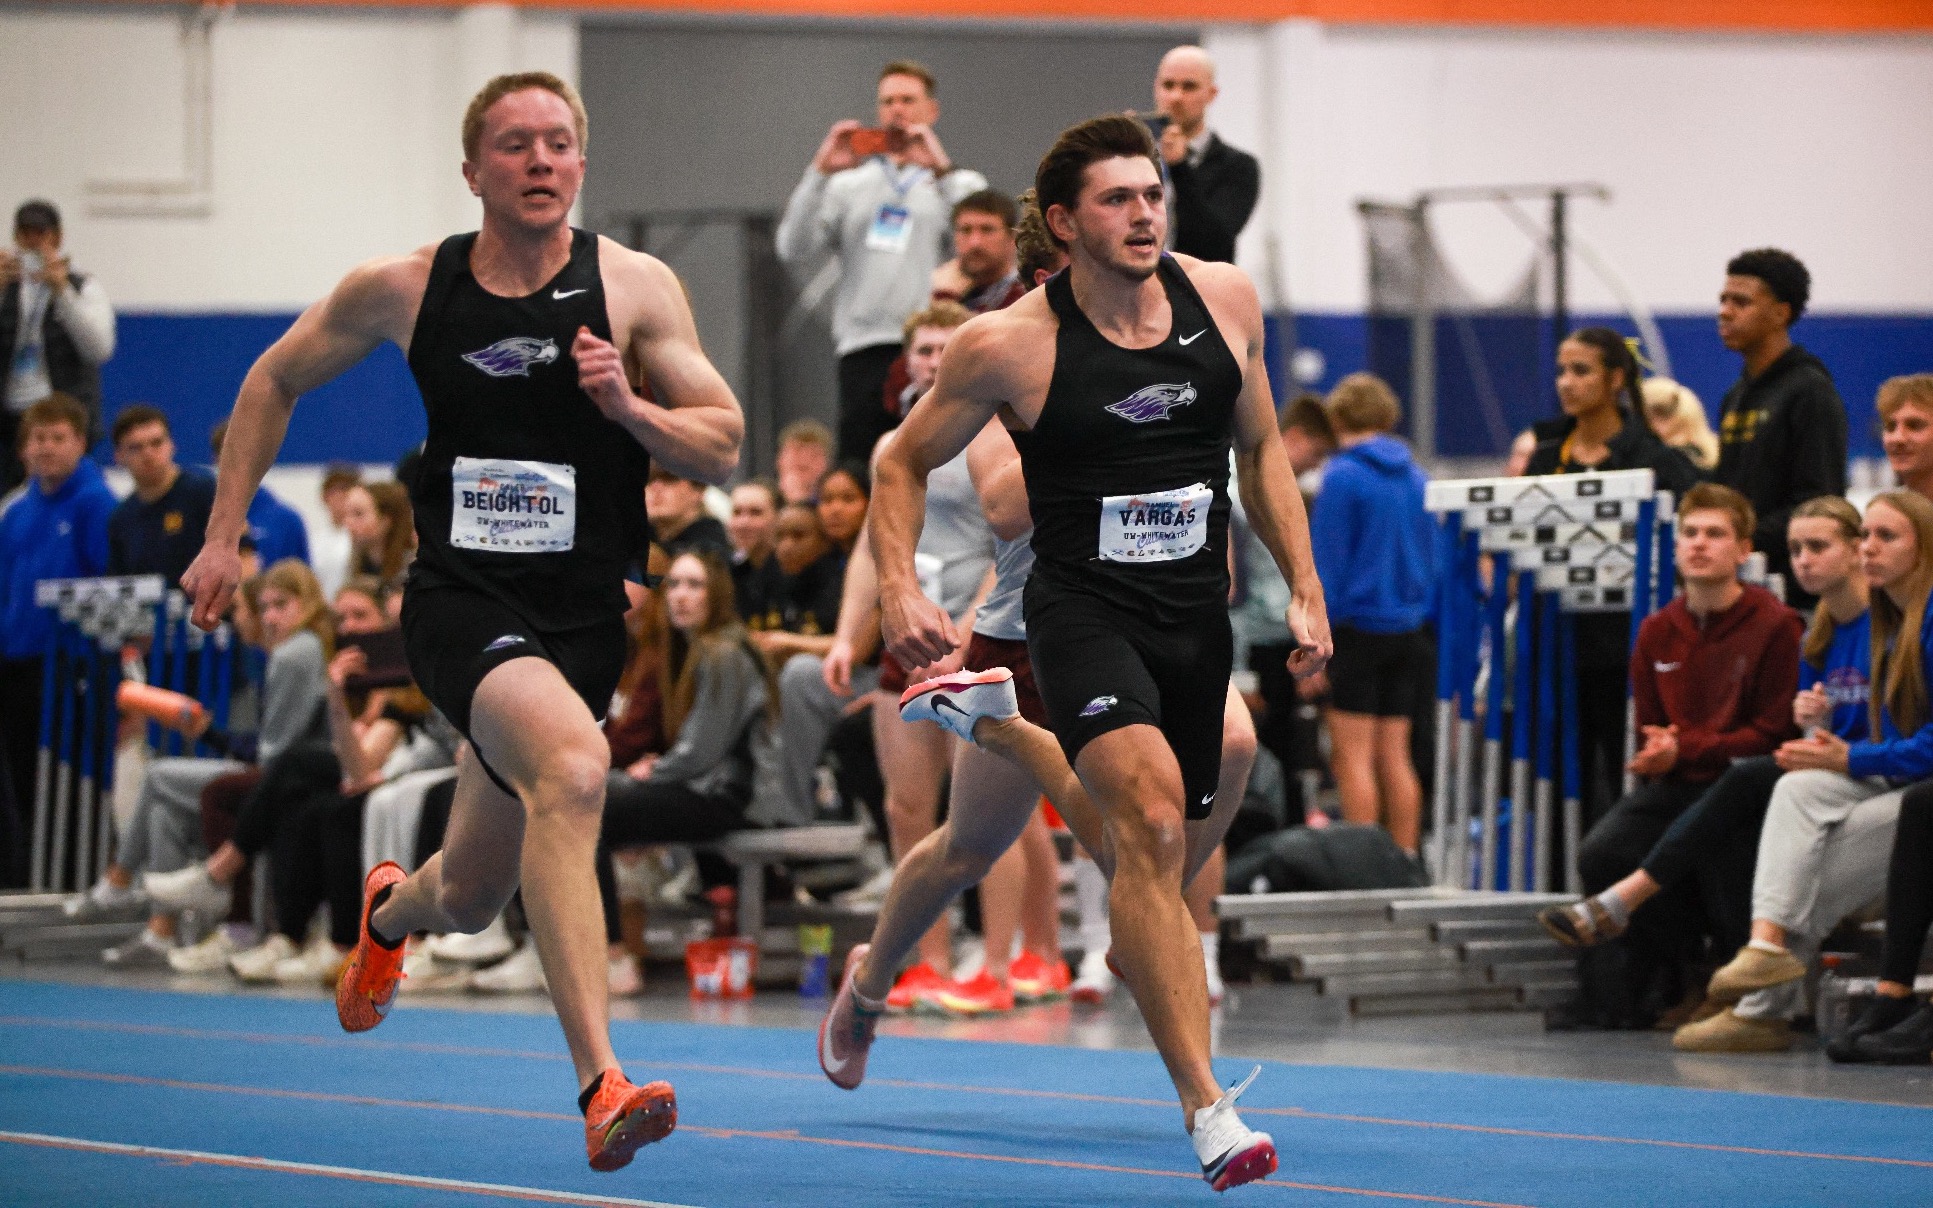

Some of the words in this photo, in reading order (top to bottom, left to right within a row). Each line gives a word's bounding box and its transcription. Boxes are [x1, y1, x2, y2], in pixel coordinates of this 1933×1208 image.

[462, 491, 564, 514] BEIGHTOL
[477, 517, 550, 528] UW-WHITEWATER
[1119, 508, 1196, 526] VARGAS
[1124, 530, 1189, 540] UW-WHITEWATER
